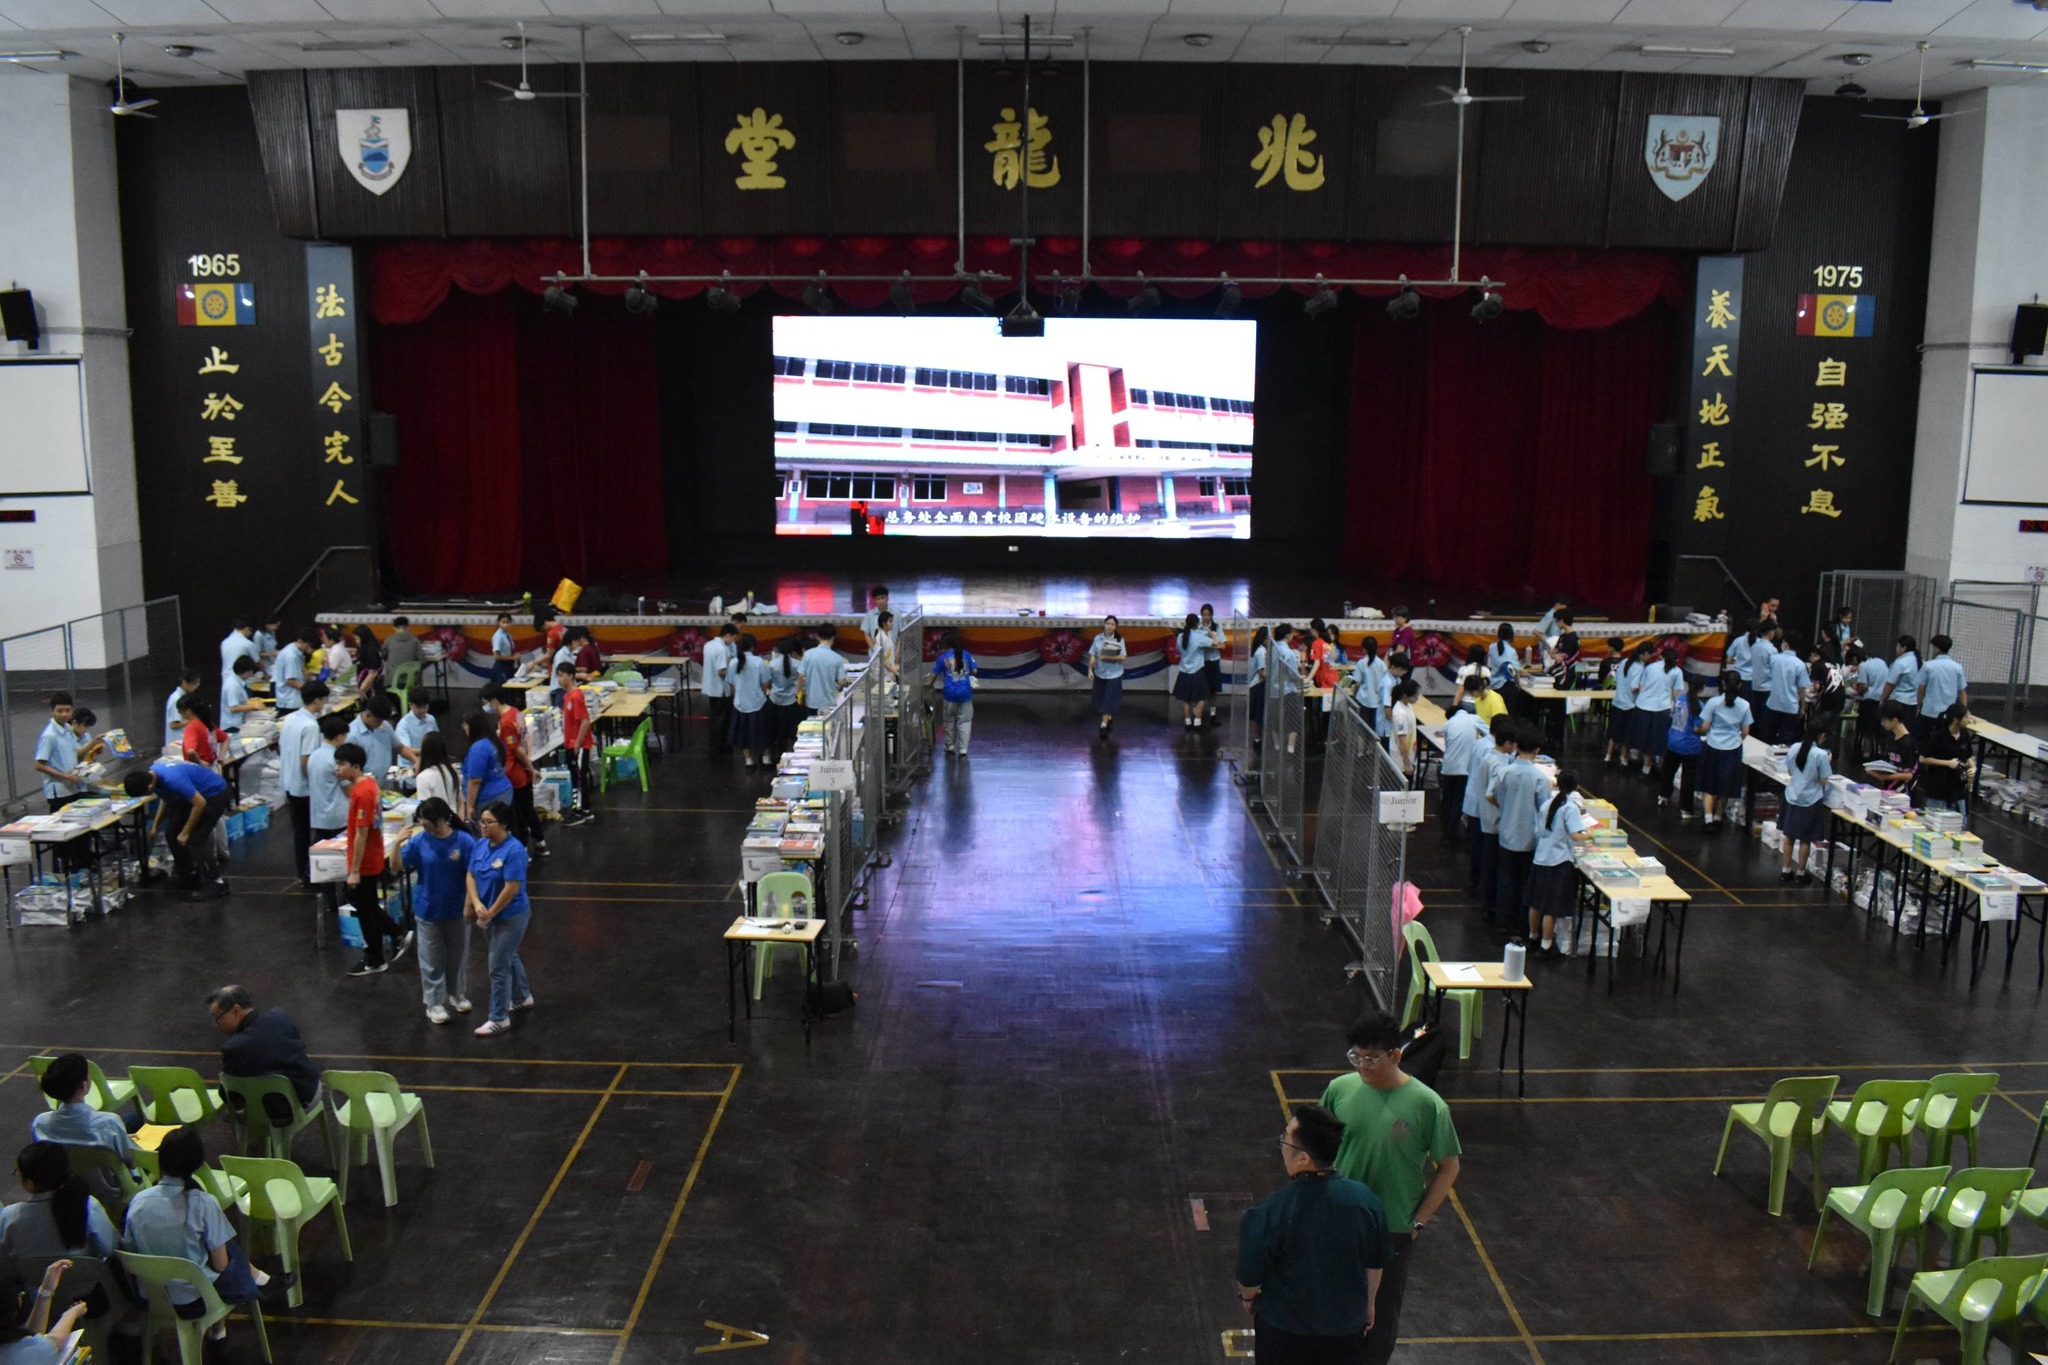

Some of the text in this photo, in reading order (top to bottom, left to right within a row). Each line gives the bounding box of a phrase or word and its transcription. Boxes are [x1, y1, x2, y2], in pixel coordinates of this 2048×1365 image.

[187, 253, 241, 277] 1965
[1813, 265, 1864, 288] 1975
[316, 283, 360, 507] 法古今完人
[197, 345, 248, 508] 止於至善
[819, 765, 846, 774] Junior
[1390, 797, 1418, 805] Junior
